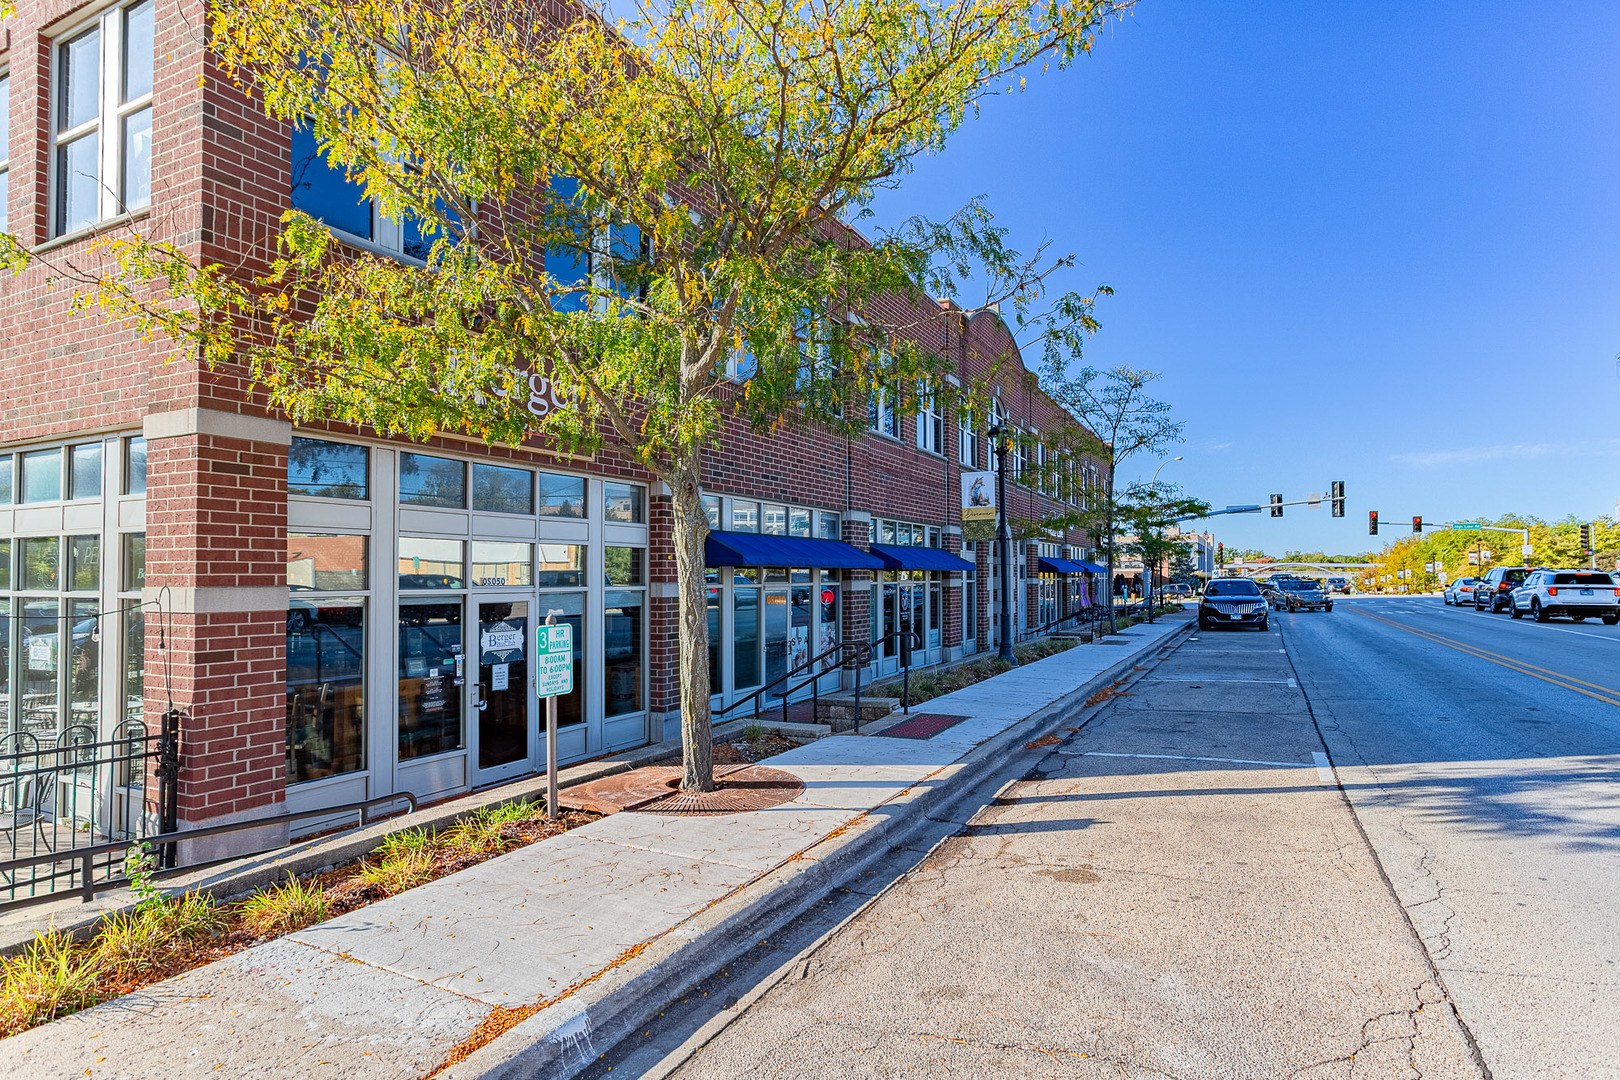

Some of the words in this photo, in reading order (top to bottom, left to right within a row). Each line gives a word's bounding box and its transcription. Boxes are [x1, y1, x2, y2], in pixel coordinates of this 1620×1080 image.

[555, 629, 565, 638] HR
[488, 633, 516, 647] Berger
[539, 631, 548, 649] 3
[549, 640, 570, 650] PARKING
[540, 666, 548, 675] TO
